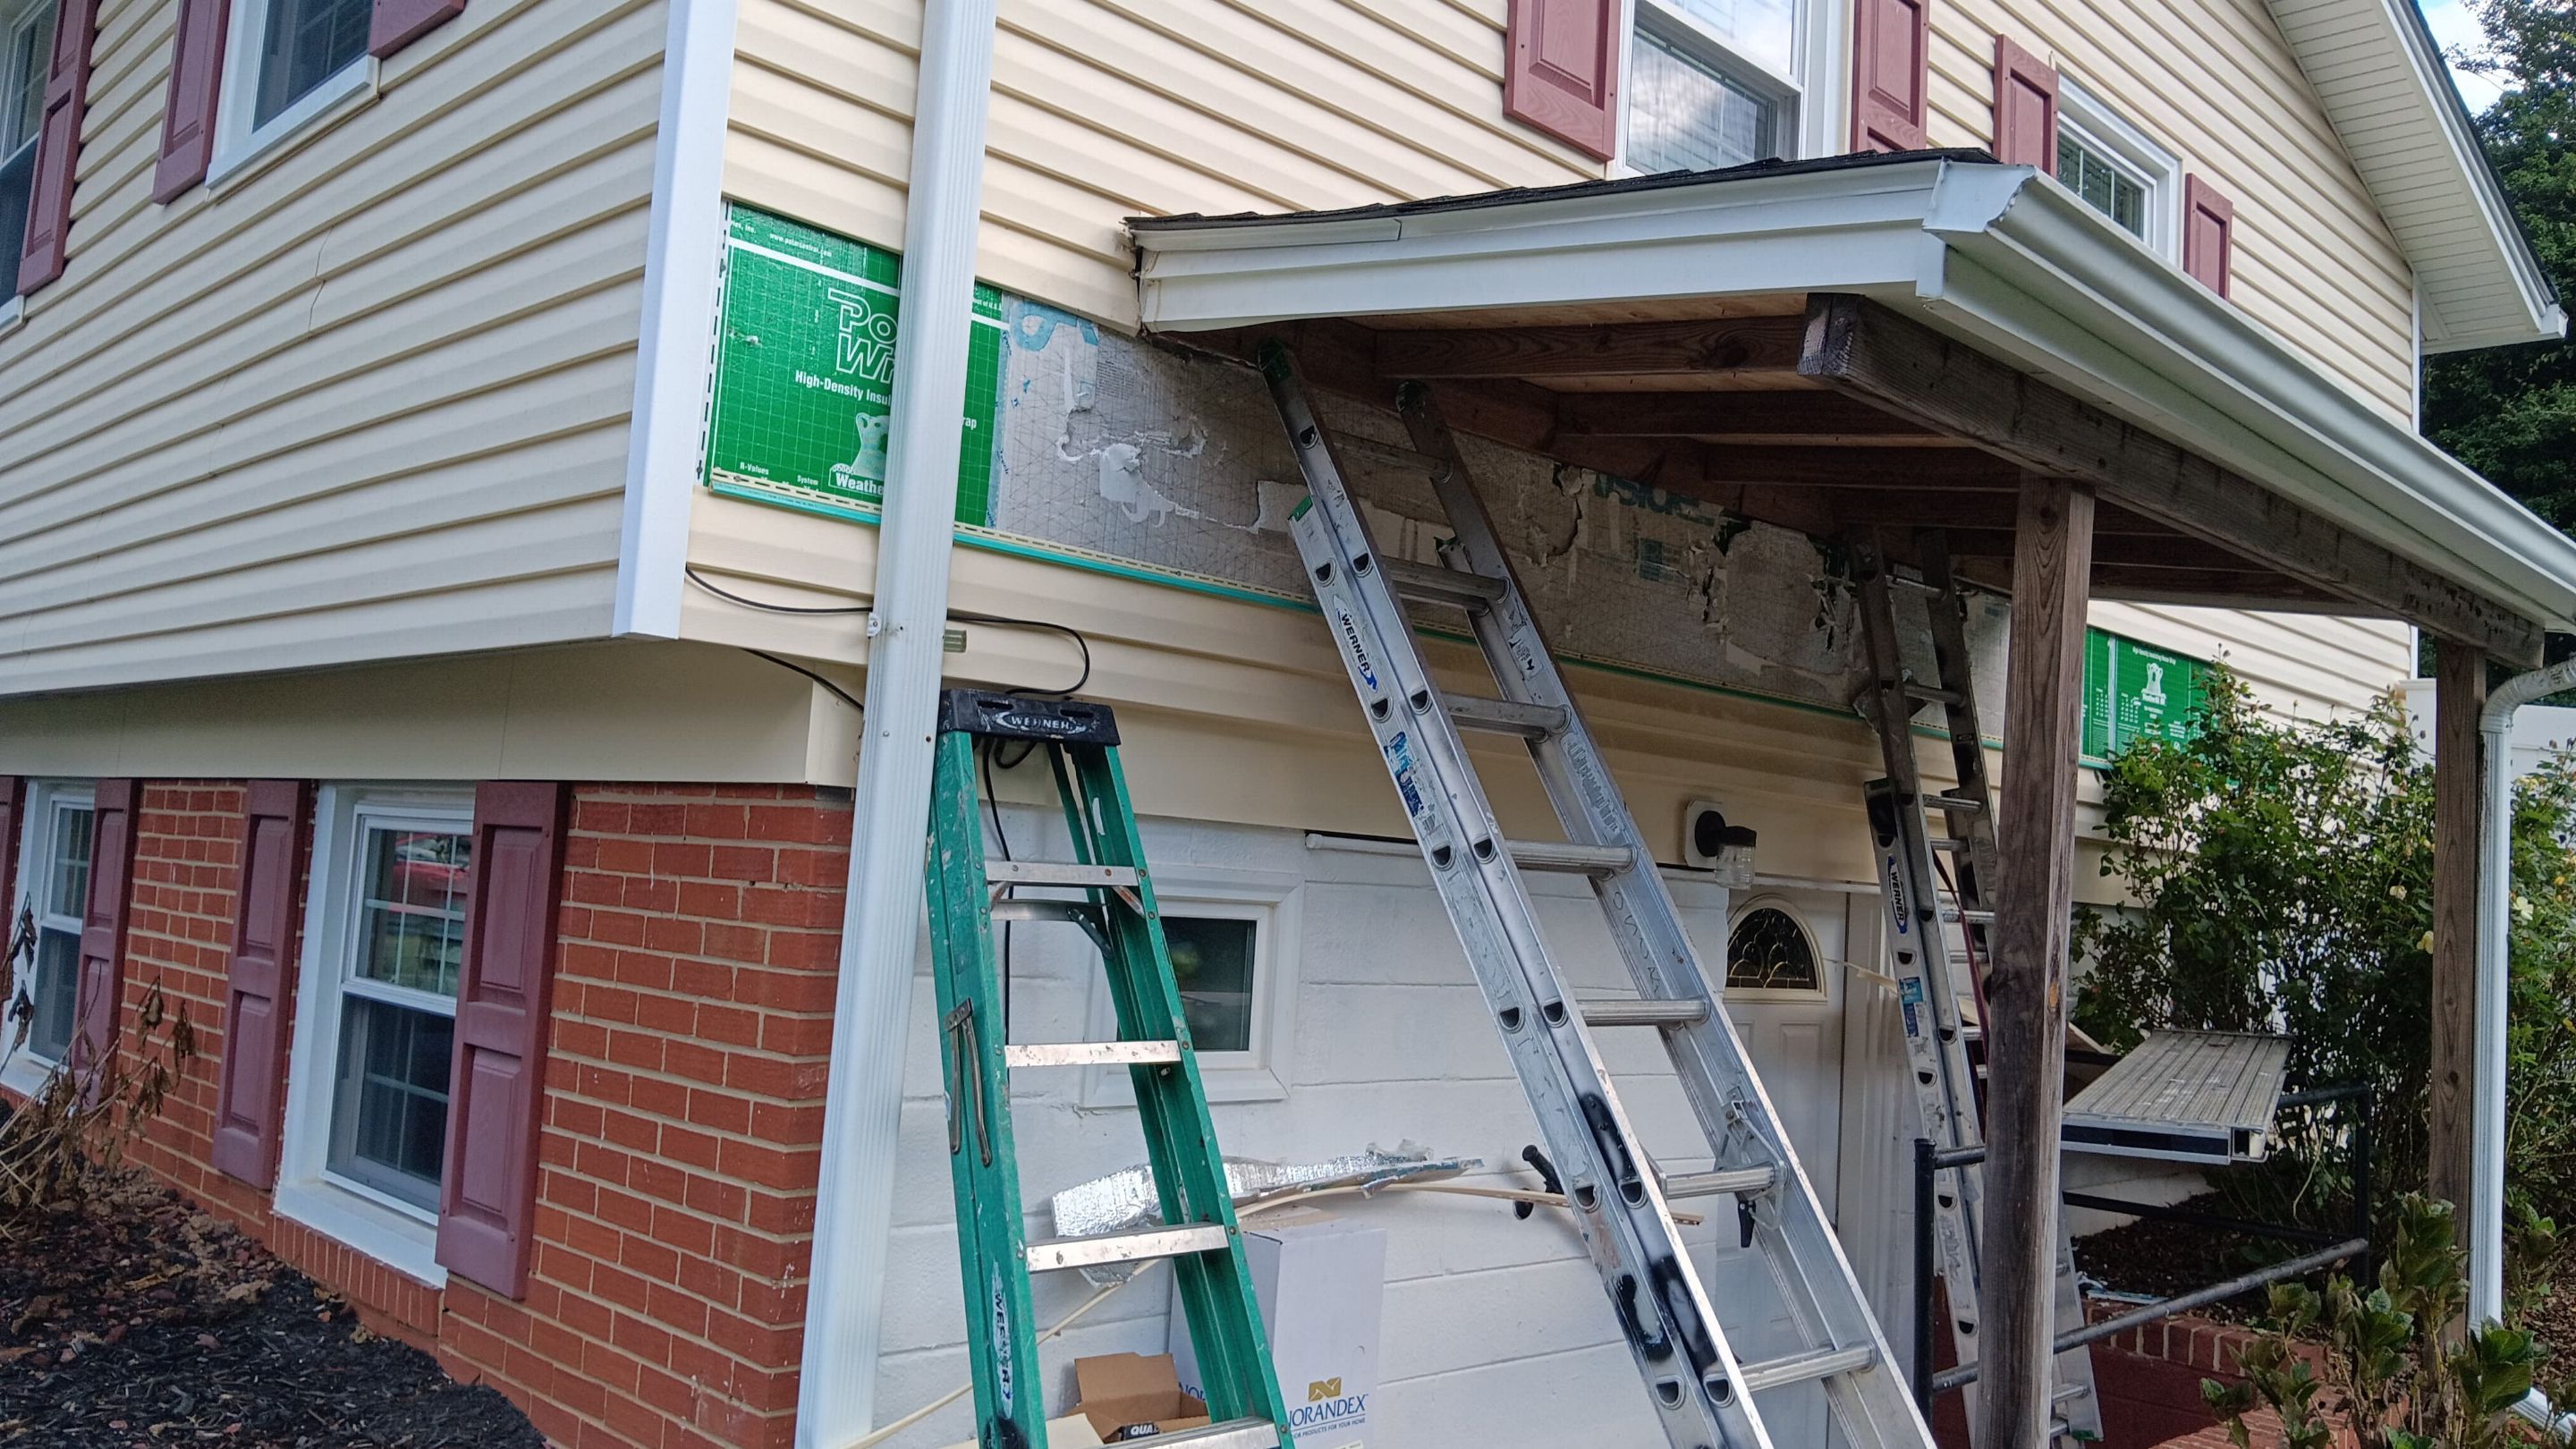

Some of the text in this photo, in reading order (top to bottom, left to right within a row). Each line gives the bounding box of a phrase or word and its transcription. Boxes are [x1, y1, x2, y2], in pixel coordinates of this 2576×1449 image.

[794, 369, 864, 402] High-Density
[1341, 613, 1371, 673] WERNER
[1891, 871, 1905, 921] WERNER
[1302, 1426, 1327, 1437] PRODUCTS
